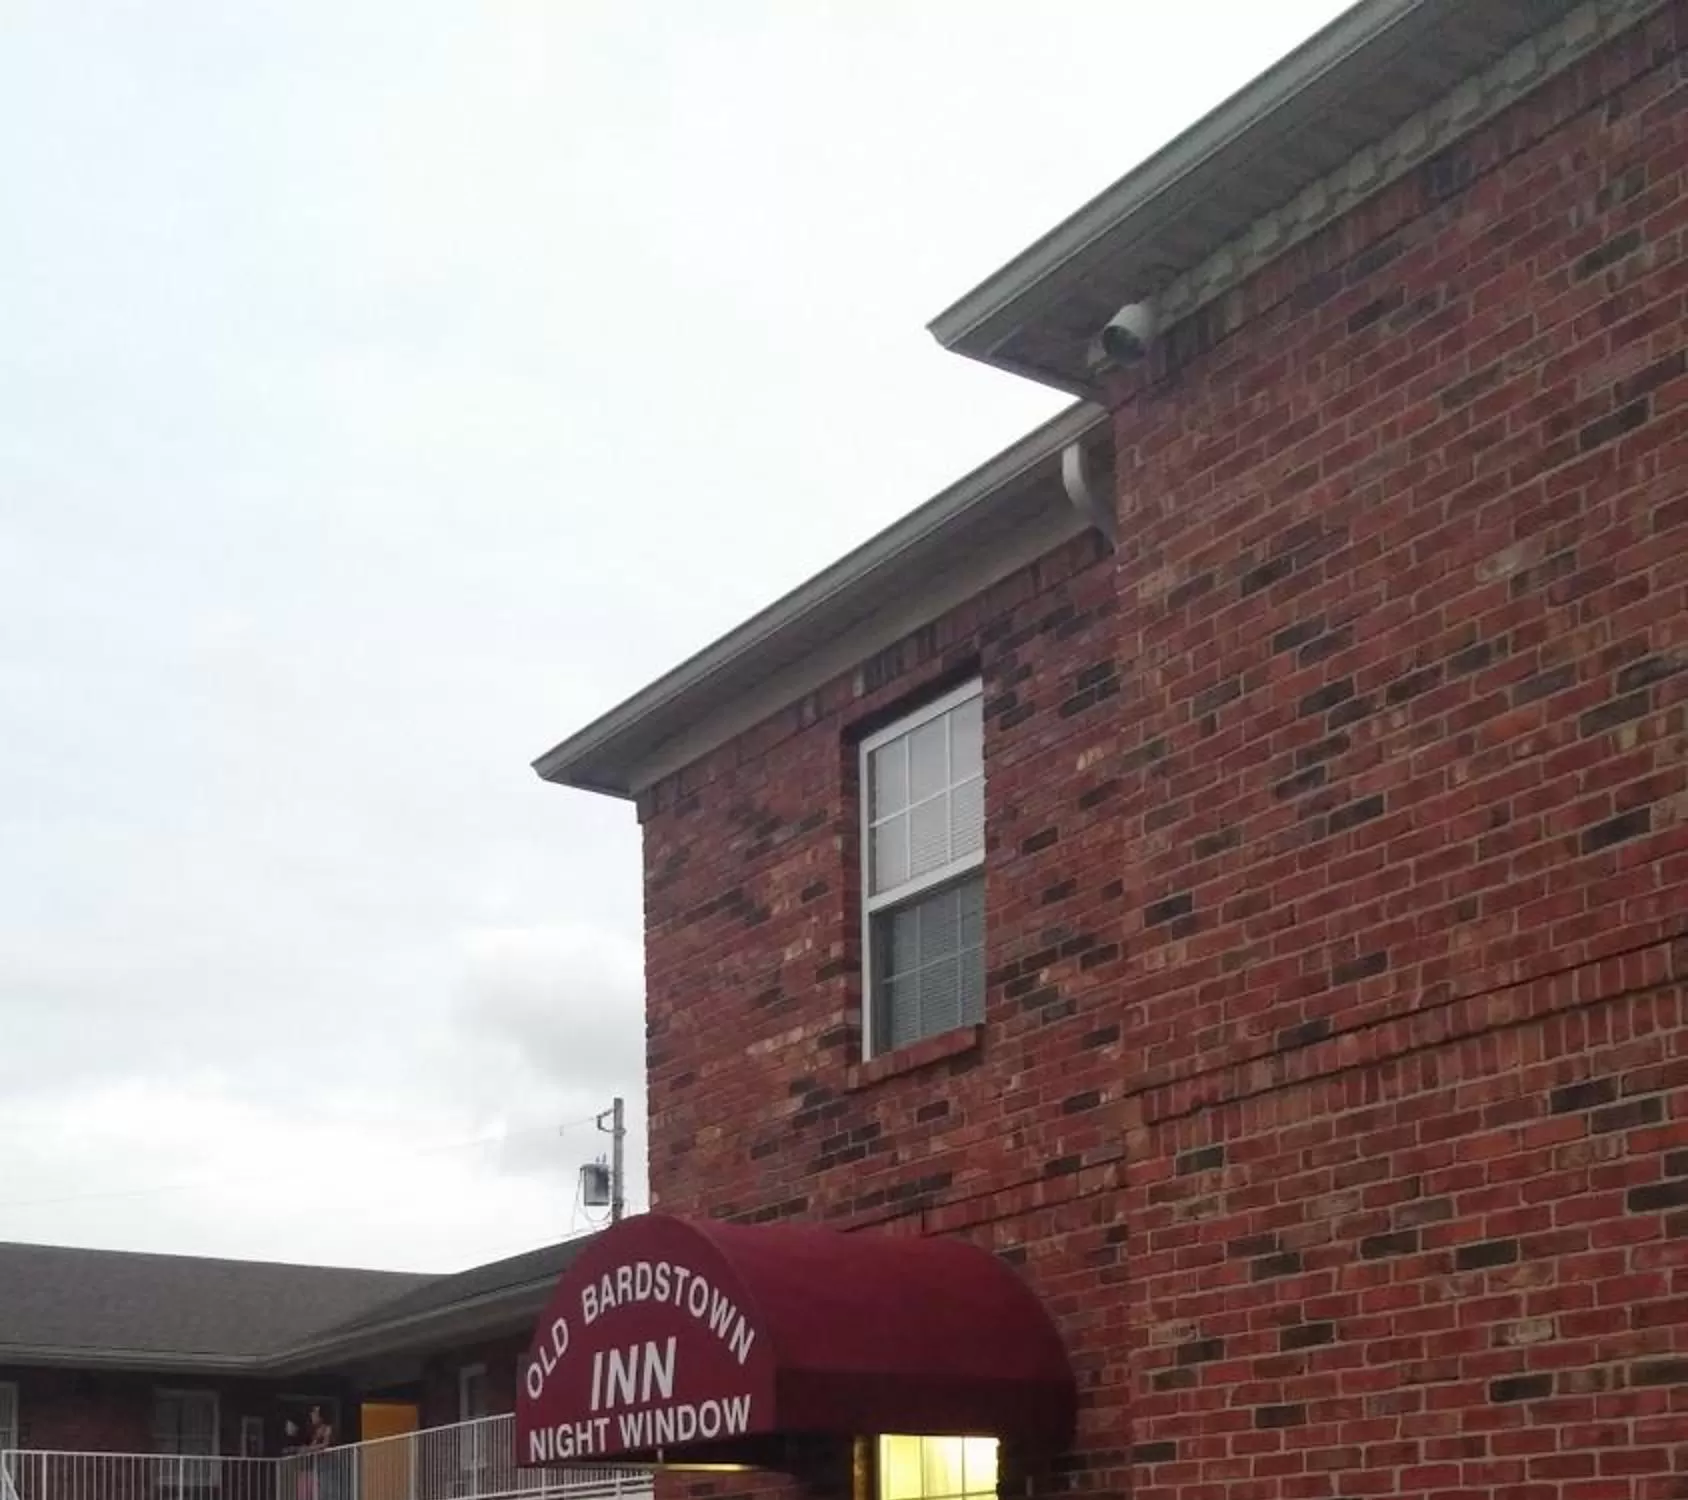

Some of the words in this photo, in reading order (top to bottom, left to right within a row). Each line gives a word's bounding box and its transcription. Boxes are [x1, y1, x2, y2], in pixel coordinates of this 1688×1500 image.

[526, 1317, 570, 1399] OLD
[581, 1260, 755, 1366] BARDSTOWN
[590, 1335, 677, 1412] INN
[529, 1417, 611, 1463] NIGHT
[619, 1393, 752, 1449] WINDOW
